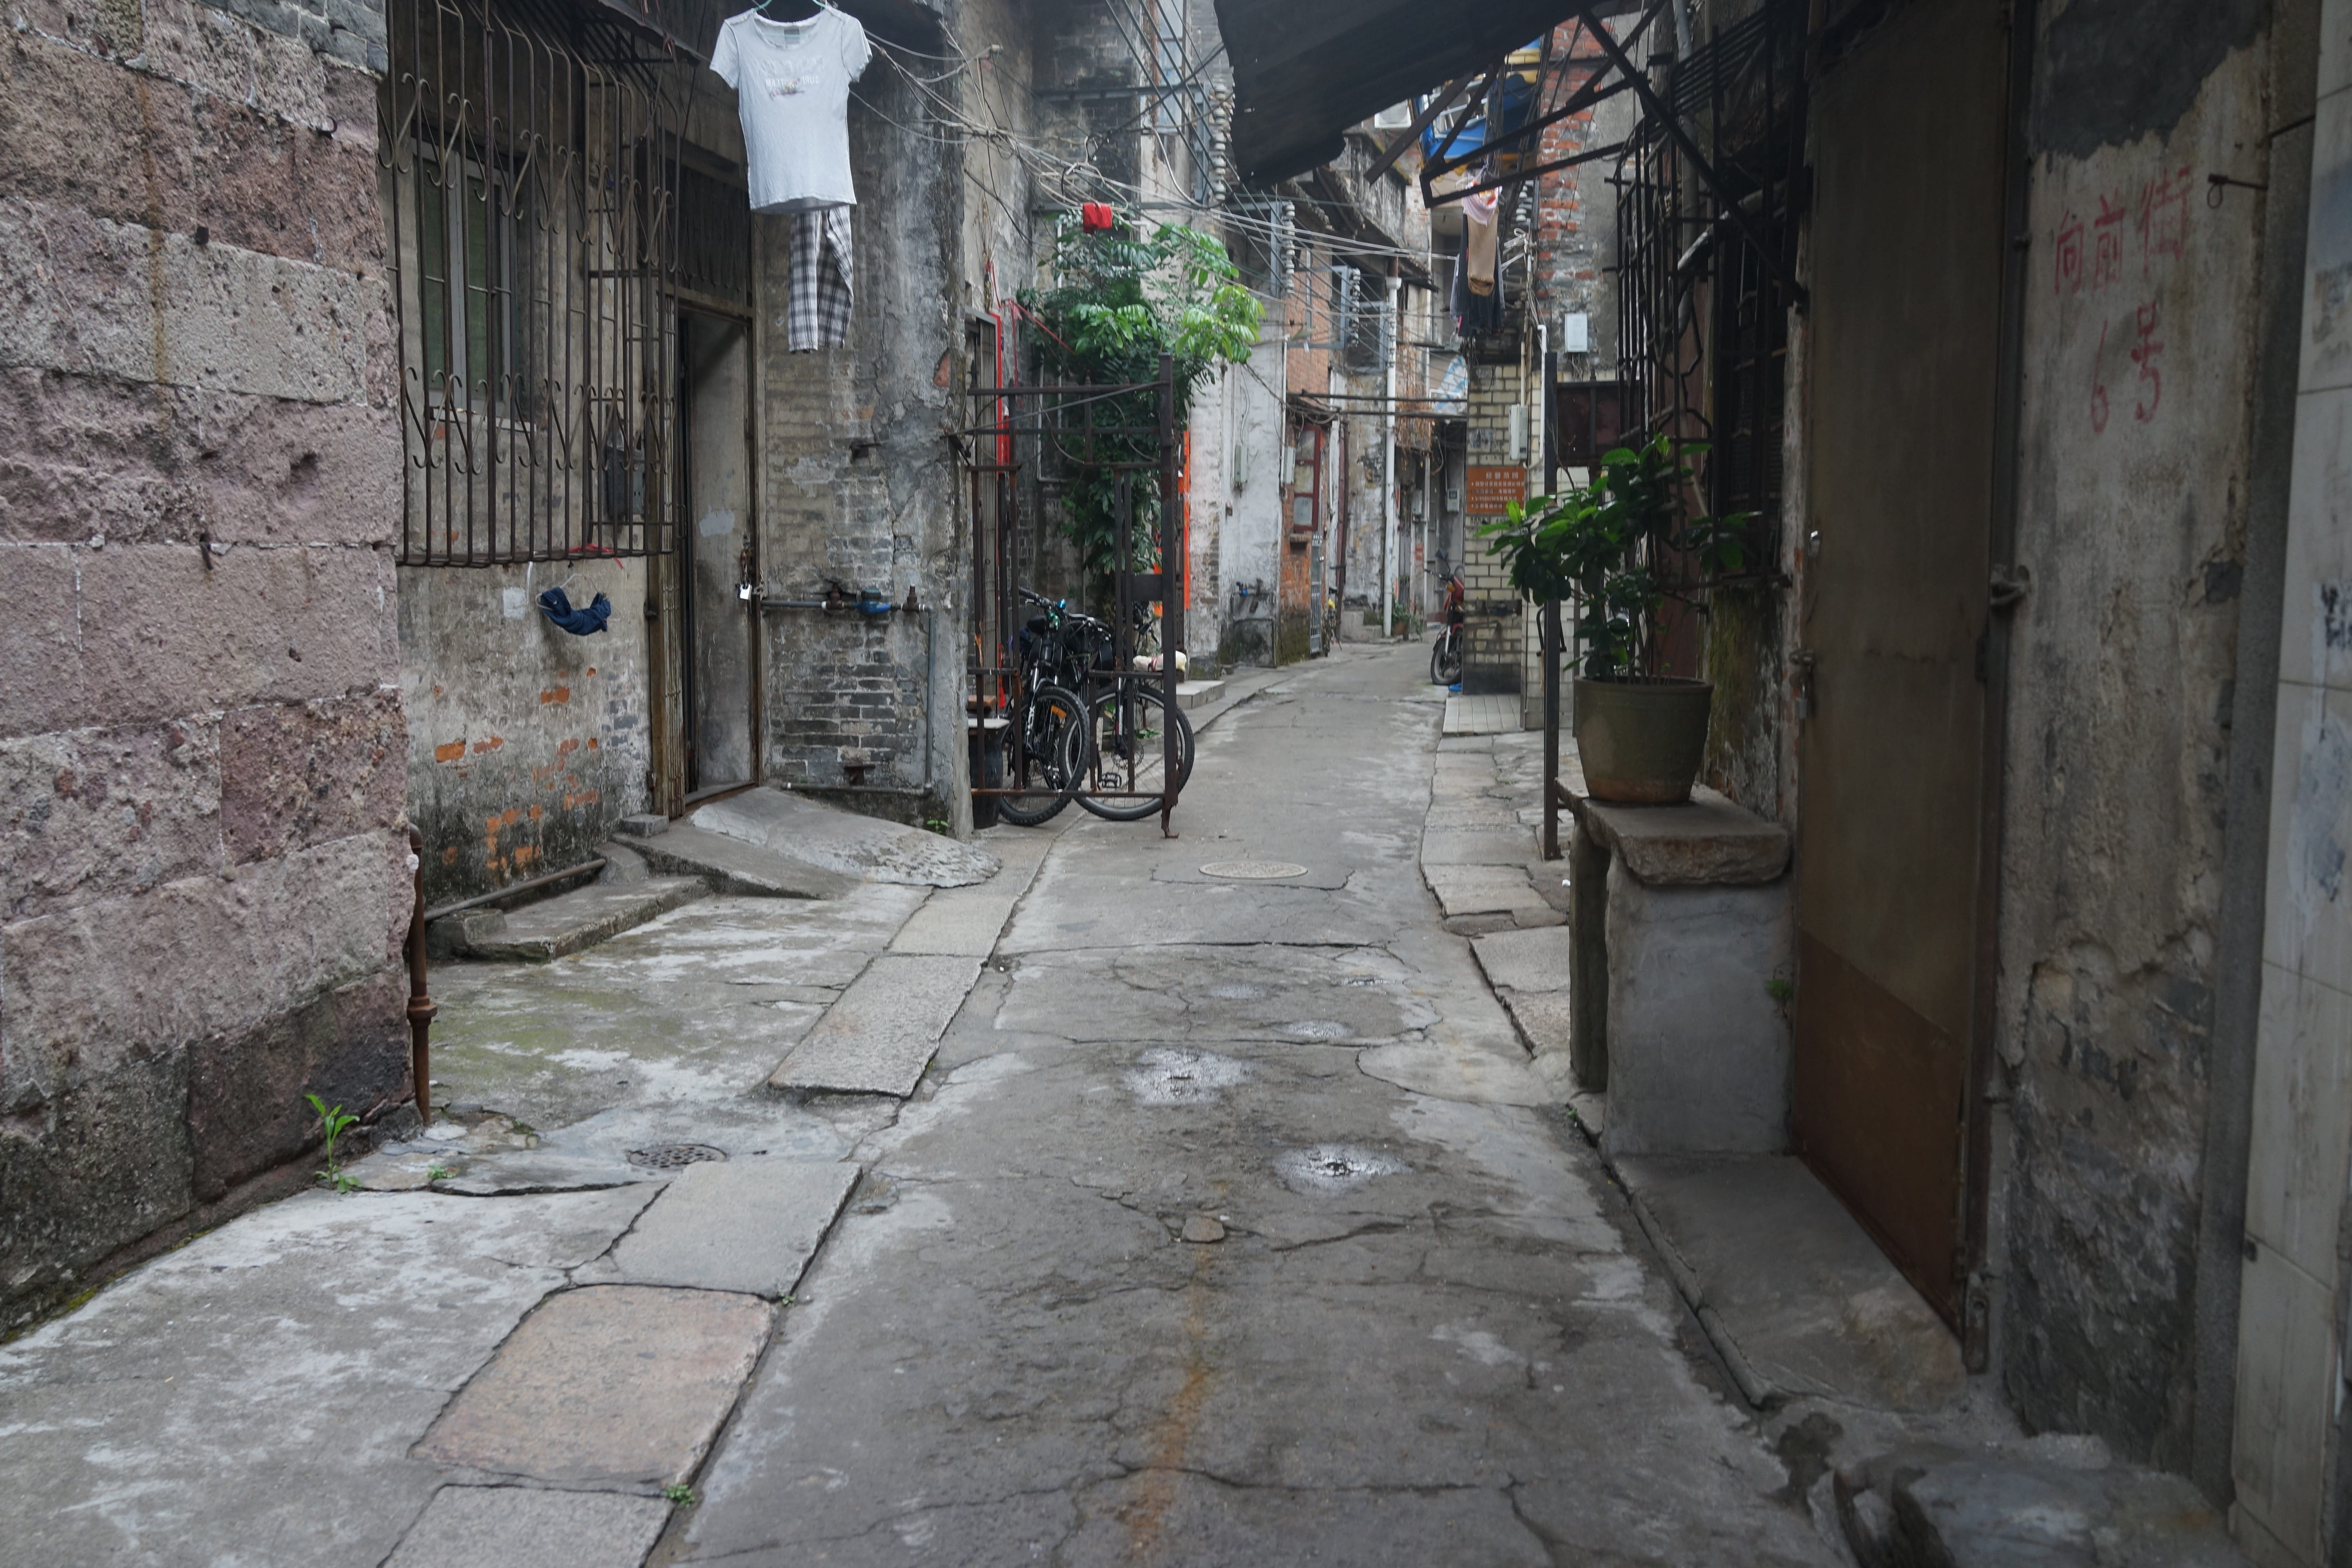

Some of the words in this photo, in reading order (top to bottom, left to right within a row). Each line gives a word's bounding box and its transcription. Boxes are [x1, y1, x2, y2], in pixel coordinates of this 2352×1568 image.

[2054, 166, 2194, 295] 向前街
[2091, 300, 2164, 433] 6号
